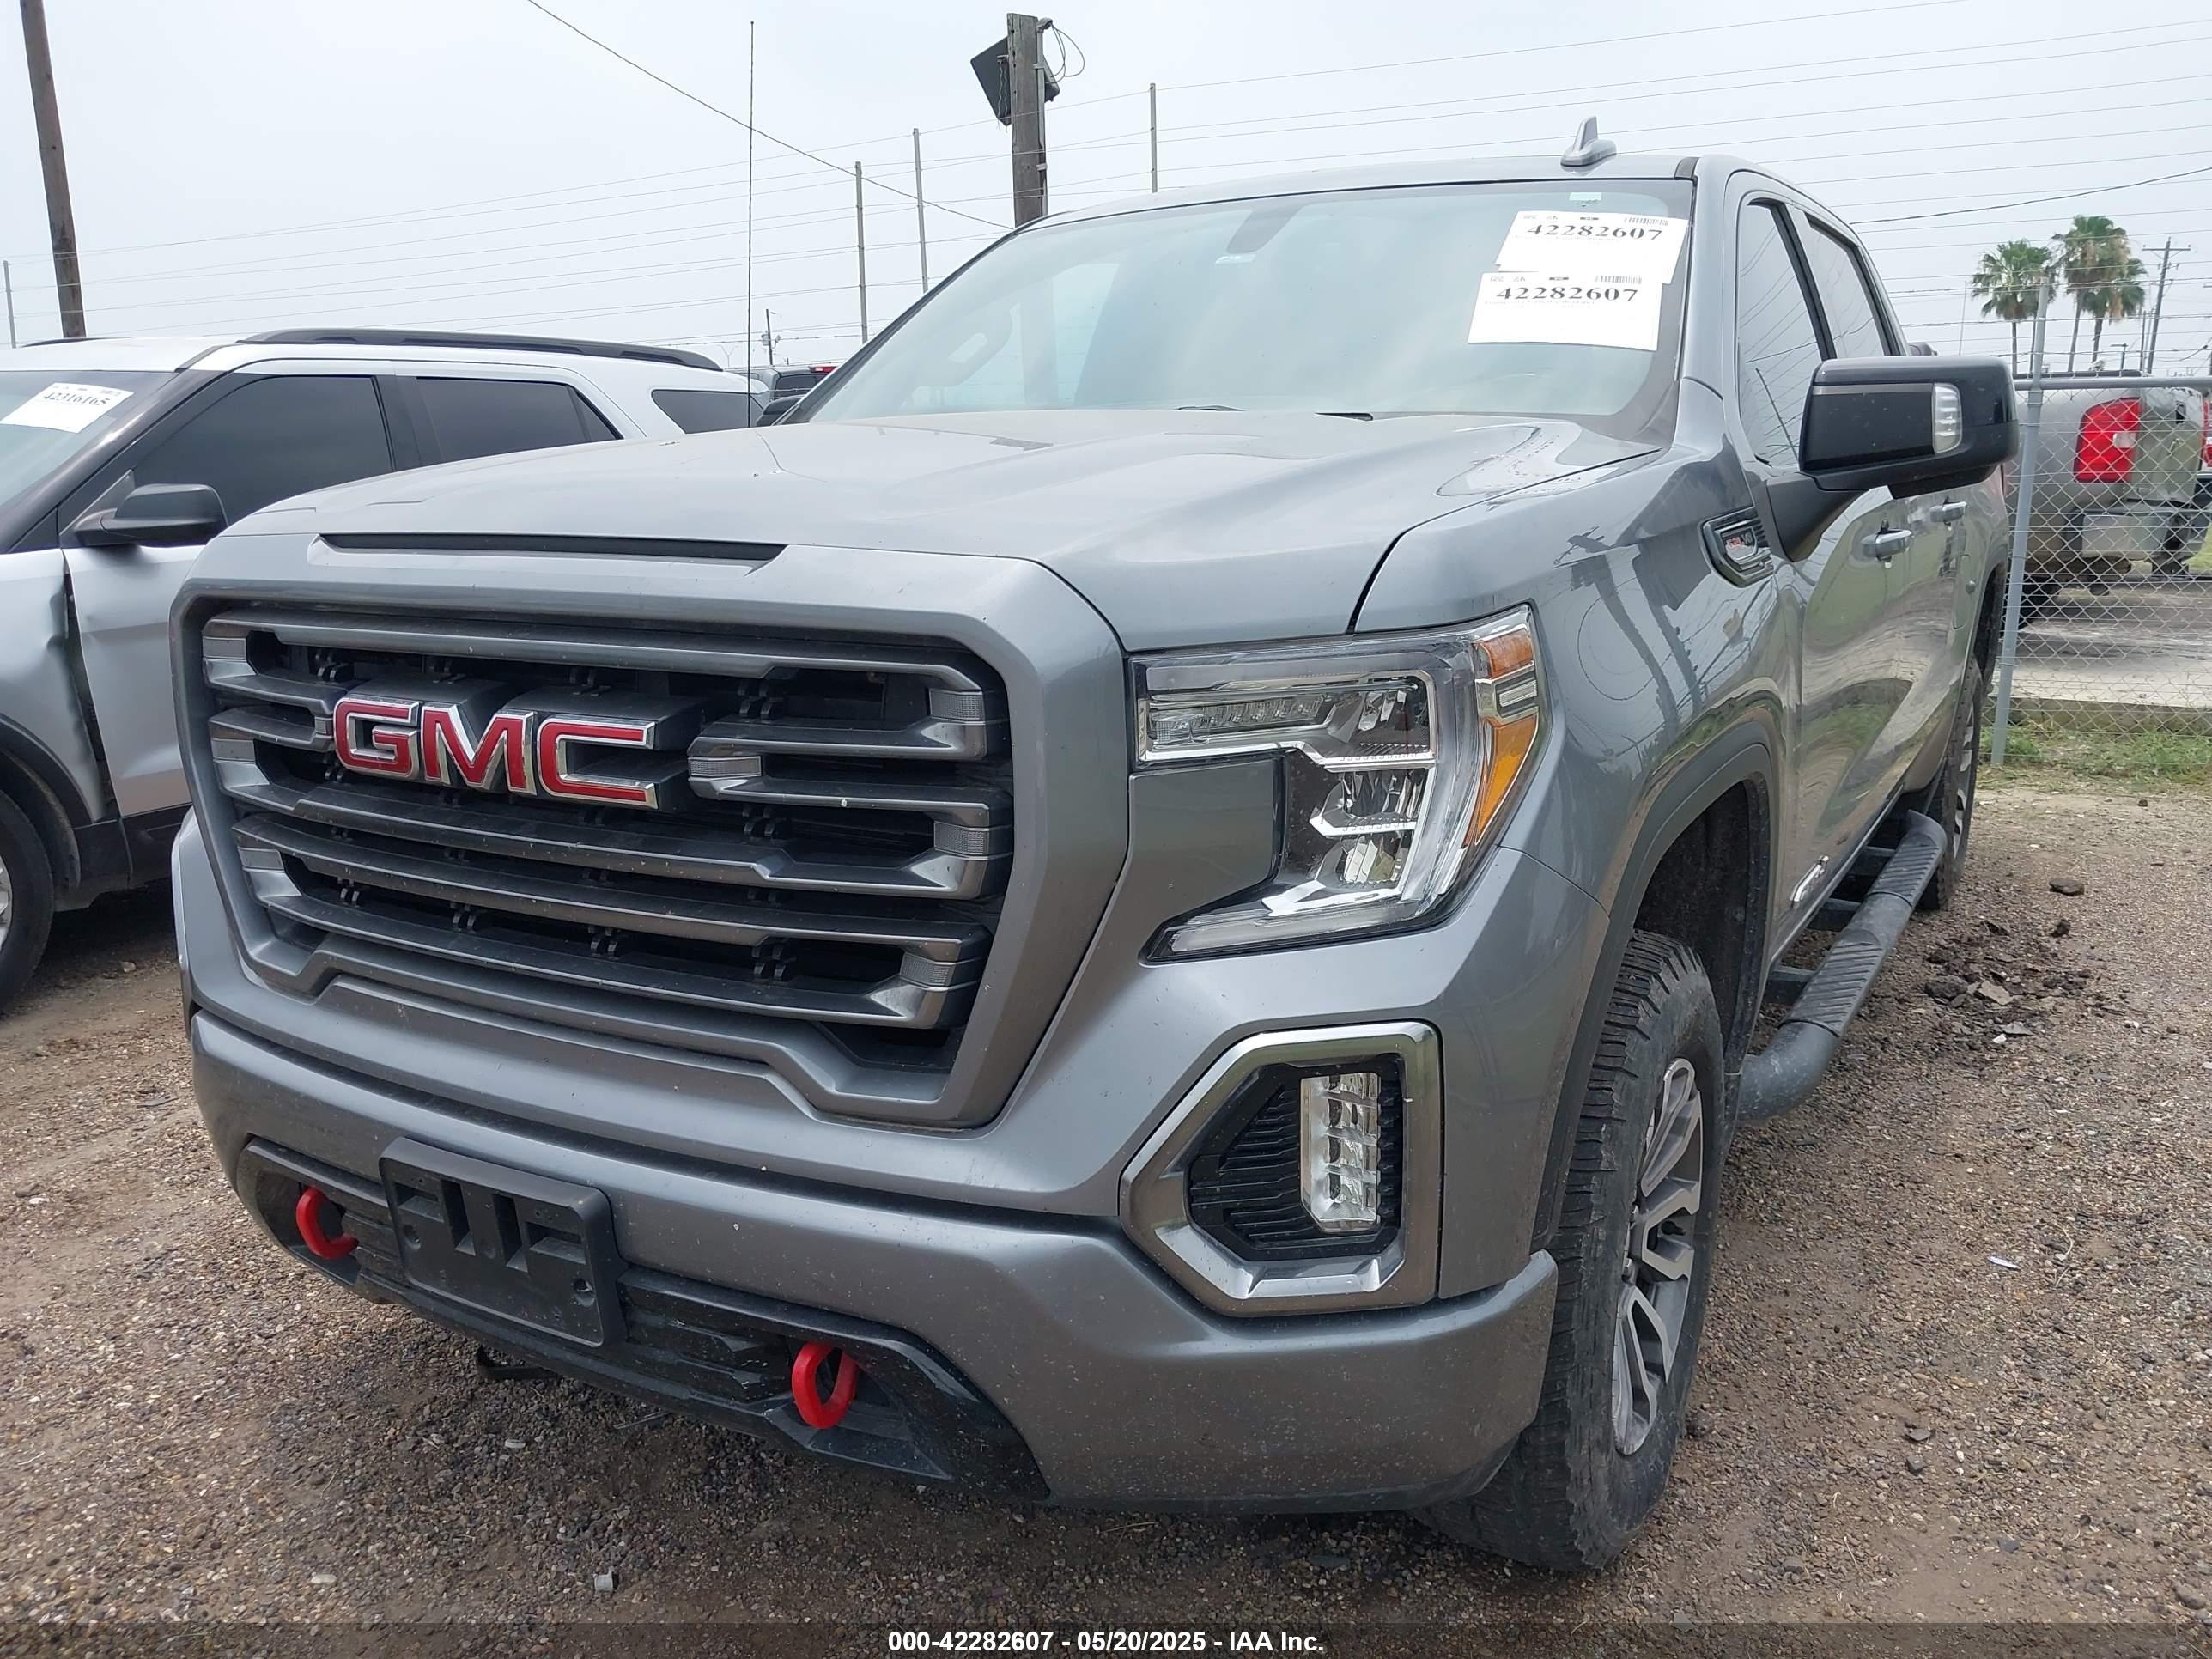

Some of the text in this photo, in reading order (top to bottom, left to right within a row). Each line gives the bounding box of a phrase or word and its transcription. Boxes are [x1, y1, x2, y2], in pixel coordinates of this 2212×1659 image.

[1528, 224, 1663, 240] 42282607
[1497, 287, 1638, 301] 42282607
[332, 697, 659, 810] GMC
